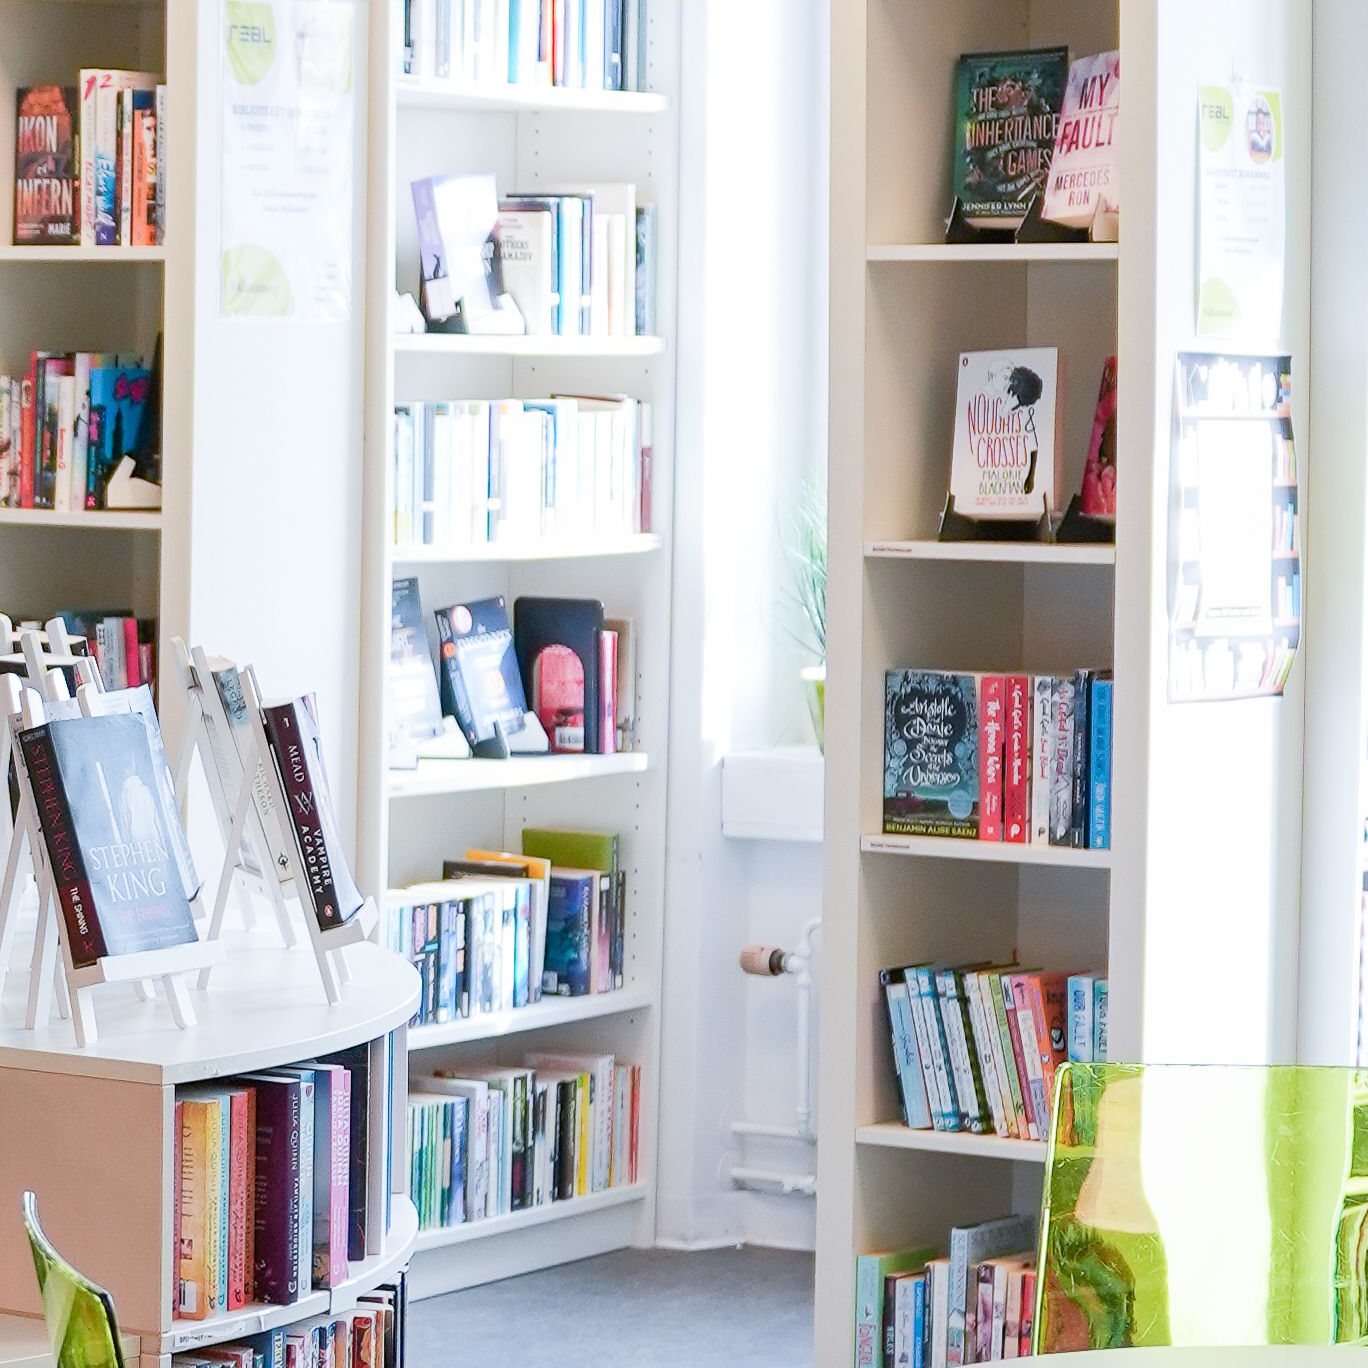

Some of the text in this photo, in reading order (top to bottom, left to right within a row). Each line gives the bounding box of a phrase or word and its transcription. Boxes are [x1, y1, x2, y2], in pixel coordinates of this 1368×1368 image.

[972, 87, 998, 112] THE
[1079, 72, 1111, 110] MY
[965, 114, 1060, 150] INHERITANCE
[1059, 114, 1119, 154] FAULT
[1008, 148, 1052, 175] GAMES
[1055, 169, 1110, 191] MERCEDES
[1068, 190, 1090, 206] RON
[968, 392, 1038, 453] NOUGHTS &
[977, 435, 1029, 468] CROSSES
[288, 745, 305, 783] MEAD
[32, 743, 63, 829] STEPHEN
[55, 831, 76, 882] KING
[74, 903, 89, 936] SHINING
[89, 840, 170, 871] STEPHEN
[314, 827, 332, 887] VAMPIRE
[301, 825, 324, 896] ACADEMY
[109, 869, 166, 902] KING
